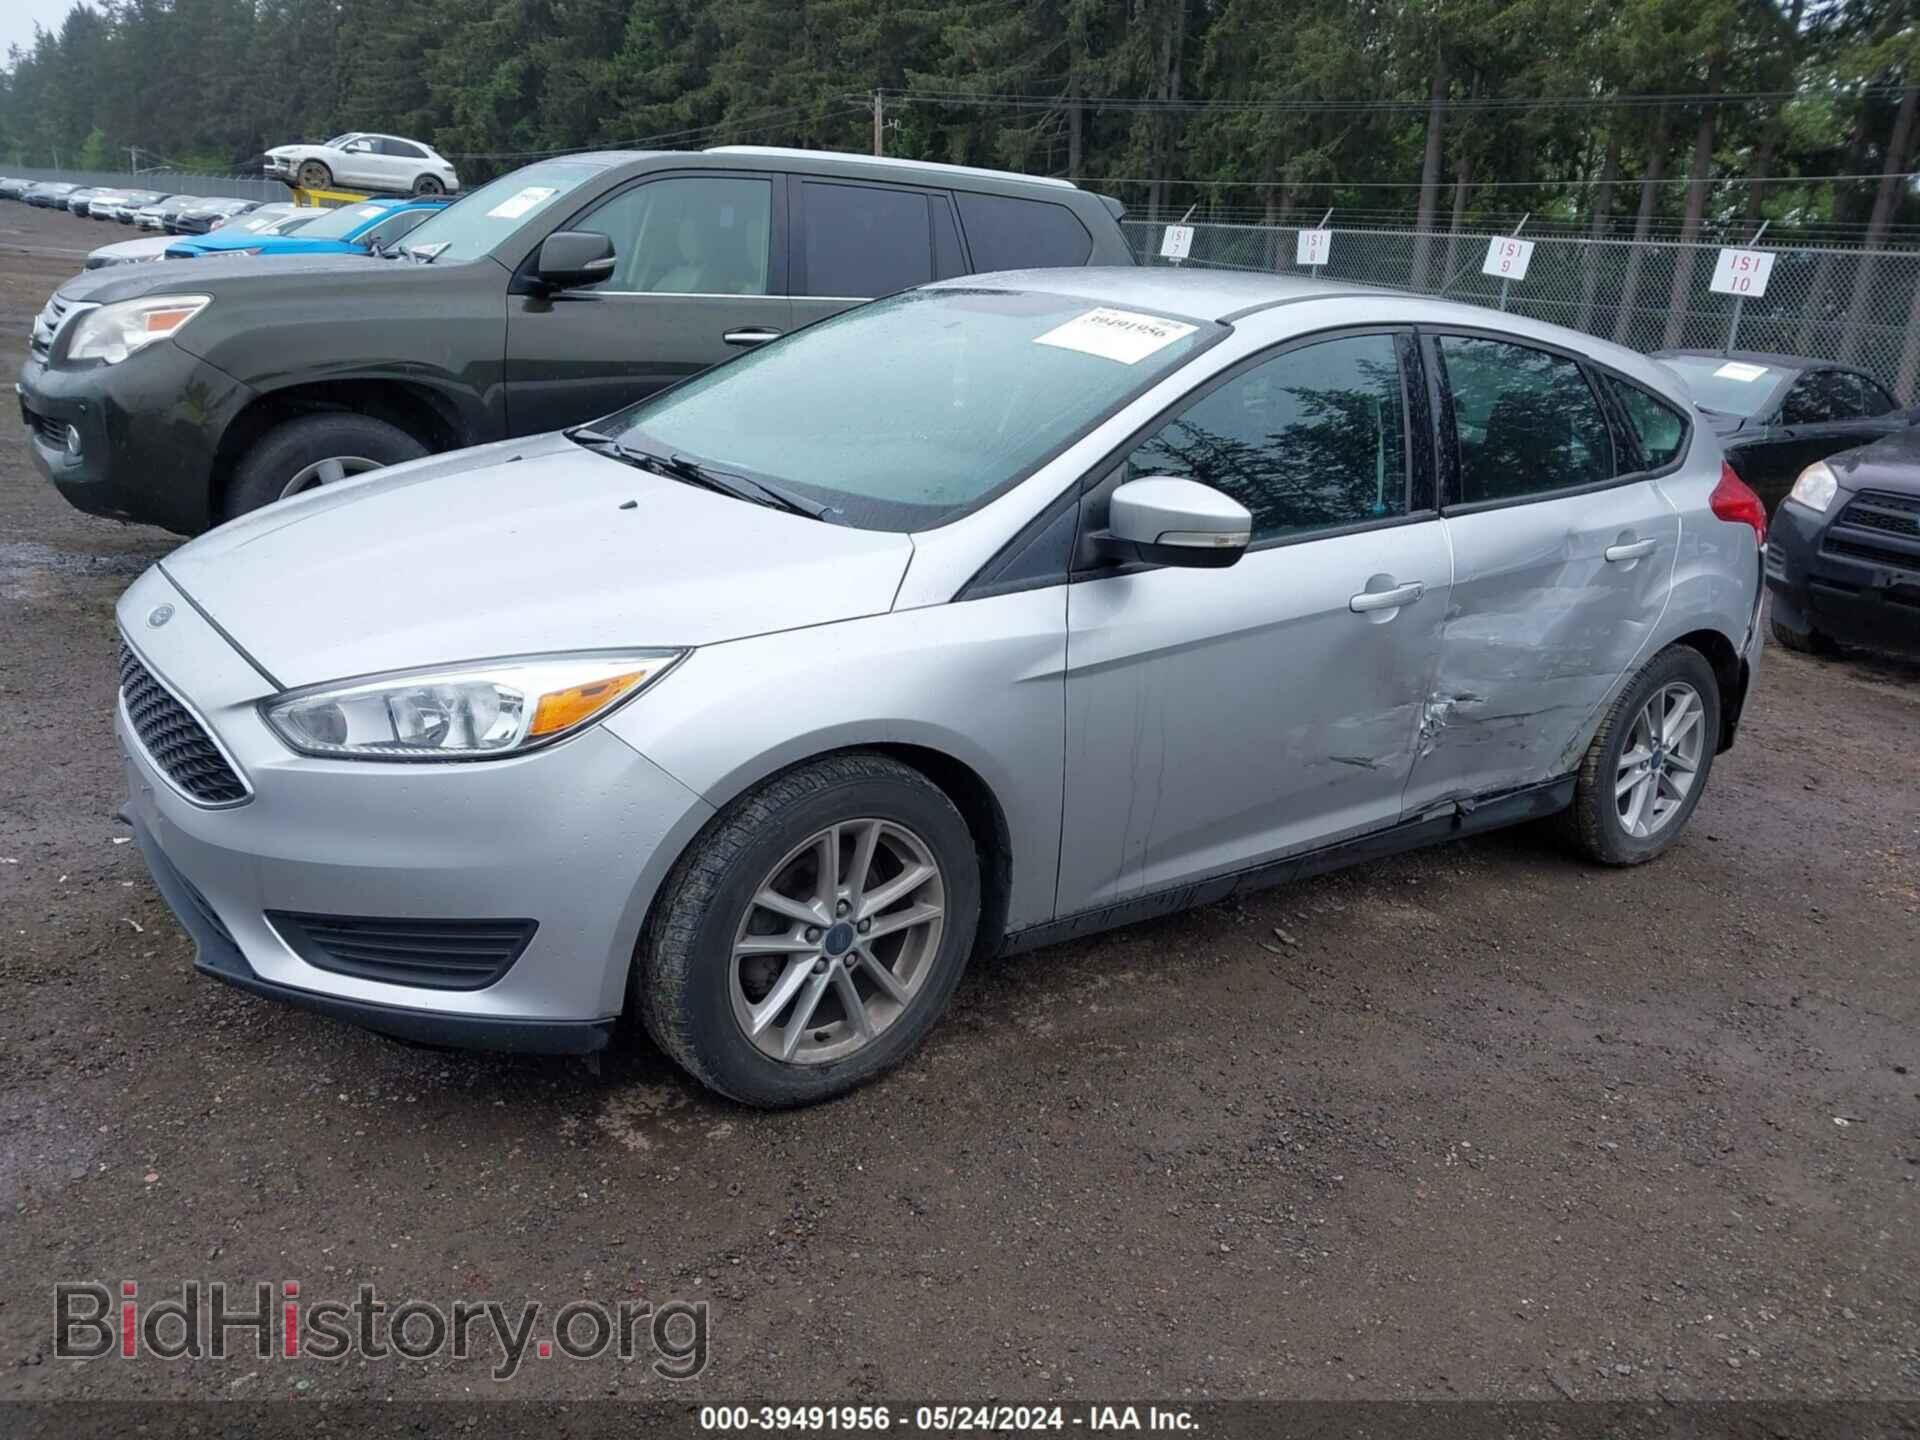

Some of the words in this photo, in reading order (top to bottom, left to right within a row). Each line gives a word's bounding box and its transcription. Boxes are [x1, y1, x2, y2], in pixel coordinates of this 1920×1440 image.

[1498, 241, 1523, 257] ISI
[1730, 254, 1761, 273] ISI
[1730, 275, 1752, 293] 10
